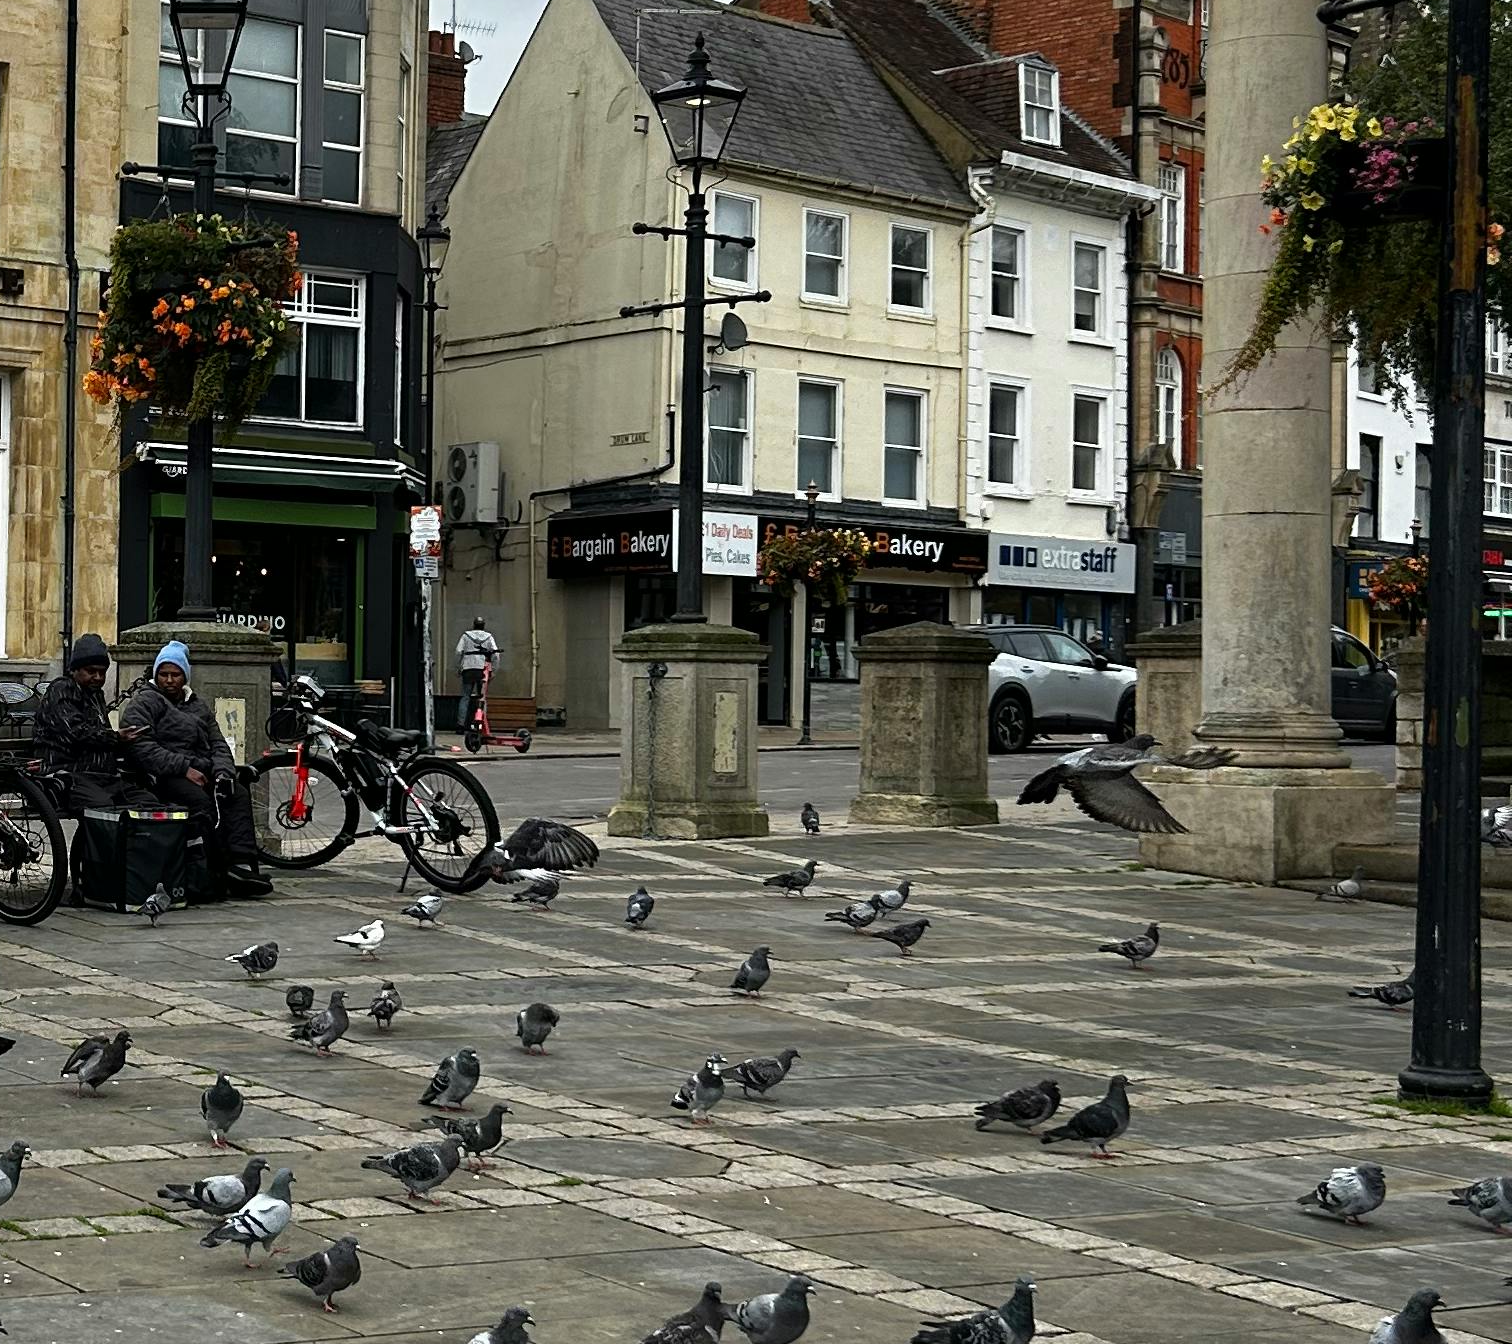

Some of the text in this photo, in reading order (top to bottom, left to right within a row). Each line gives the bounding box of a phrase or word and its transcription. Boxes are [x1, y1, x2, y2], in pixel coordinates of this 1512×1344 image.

[711, 522, 731, 542] Daily
[732, 523, 754, 540] Deals
[563, 533, 615, 562] Bargain
[620, 530, 670, 557] Bakery
[727, 548, 752, 564] Cakes
[875, 532, 944, 562] Bakery
[1041, 546, 1118, 573] extrastaff
